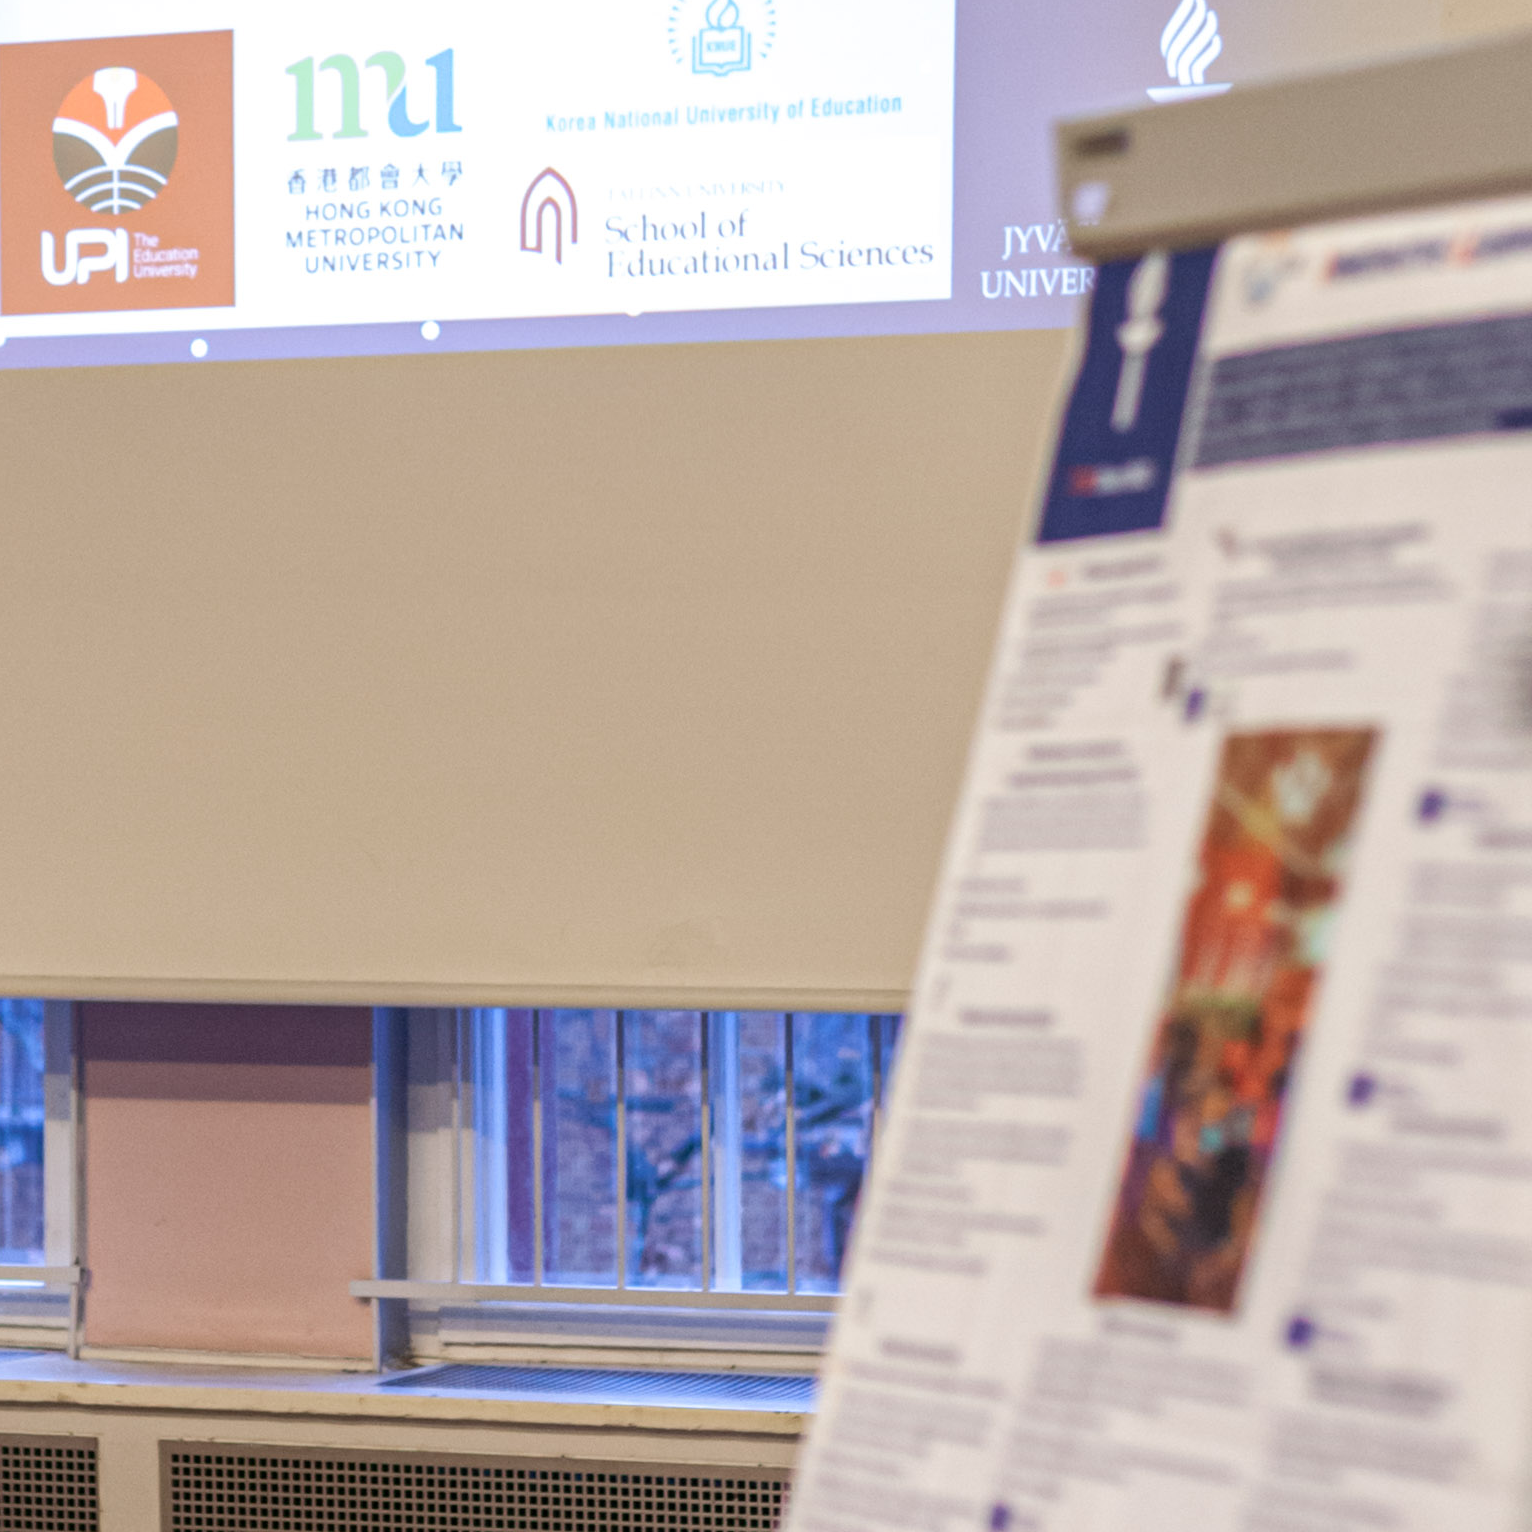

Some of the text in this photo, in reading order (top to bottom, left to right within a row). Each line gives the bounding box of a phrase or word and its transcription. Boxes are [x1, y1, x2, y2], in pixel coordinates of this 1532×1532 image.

[547, 95, 902, 131] Korea National University of Education
[306, 197, 443, 221] HONG KONG
[287, 223, 463, 247] METROPOLITAN
[605, 208, 749, 244] School of
[133, 232, 159, 247] The
[41, 228, 129, 286] UPI
[133, 248, 199, 263] Education
[306, 250, 441, 274] UNIVERSITY
[608, 239, 934, 278] Educational Sciences
[133, 263, 198, 279] University
